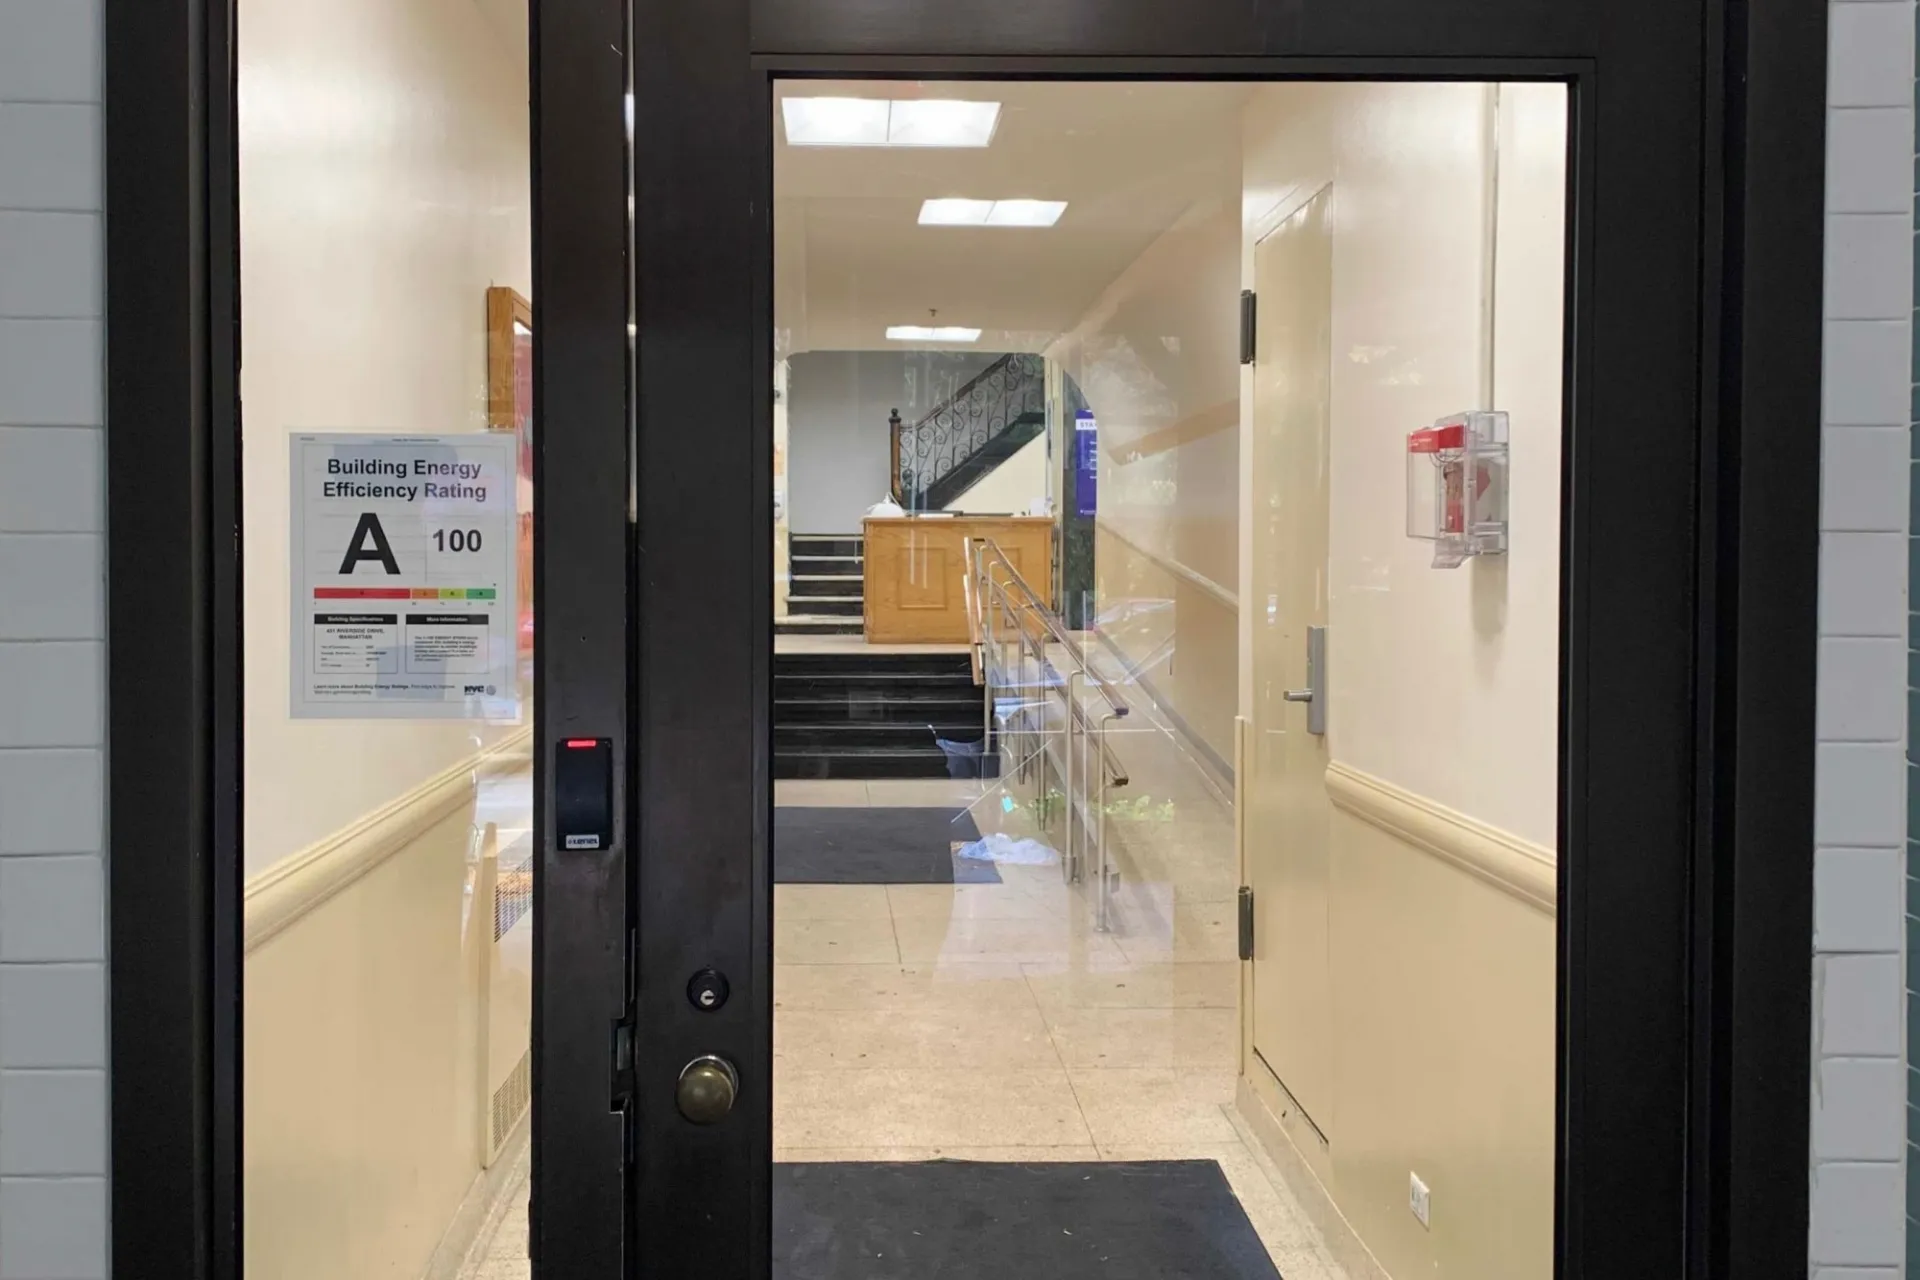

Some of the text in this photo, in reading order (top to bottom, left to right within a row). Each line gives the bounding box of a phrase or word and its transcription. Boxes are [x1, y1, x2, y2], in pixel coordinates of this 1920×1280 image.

[328, 459, 481, 479] Building Energy
[323, 482, 486, 502] Efficiency Rating
[338, 512, 401, 574] A
[432, 529, 482, 552] 100
